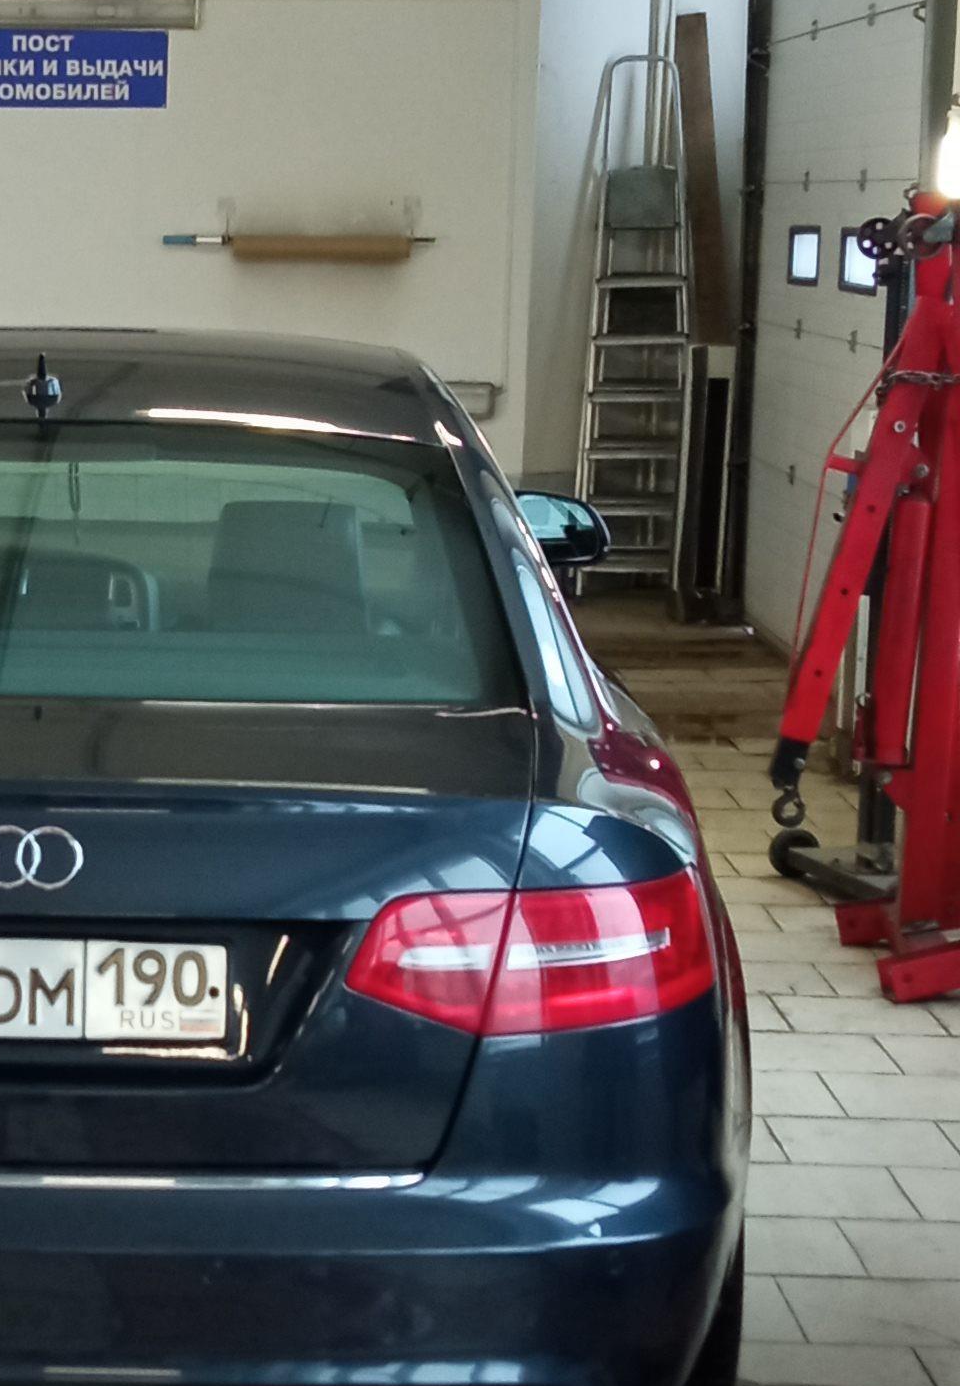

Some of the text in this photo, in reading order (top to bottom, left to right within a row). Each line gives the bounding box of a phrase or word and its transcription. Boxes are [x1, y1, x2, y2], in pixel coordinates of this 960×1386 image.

[12, 34, 73, 53] ПОСТ
[43, 59, 58, 76] И
[66, 59, 164, 80] ВЫДАЧИ
[96, 948, 208, 1008] 190
[119, 1011, 175, 1030] RUS
